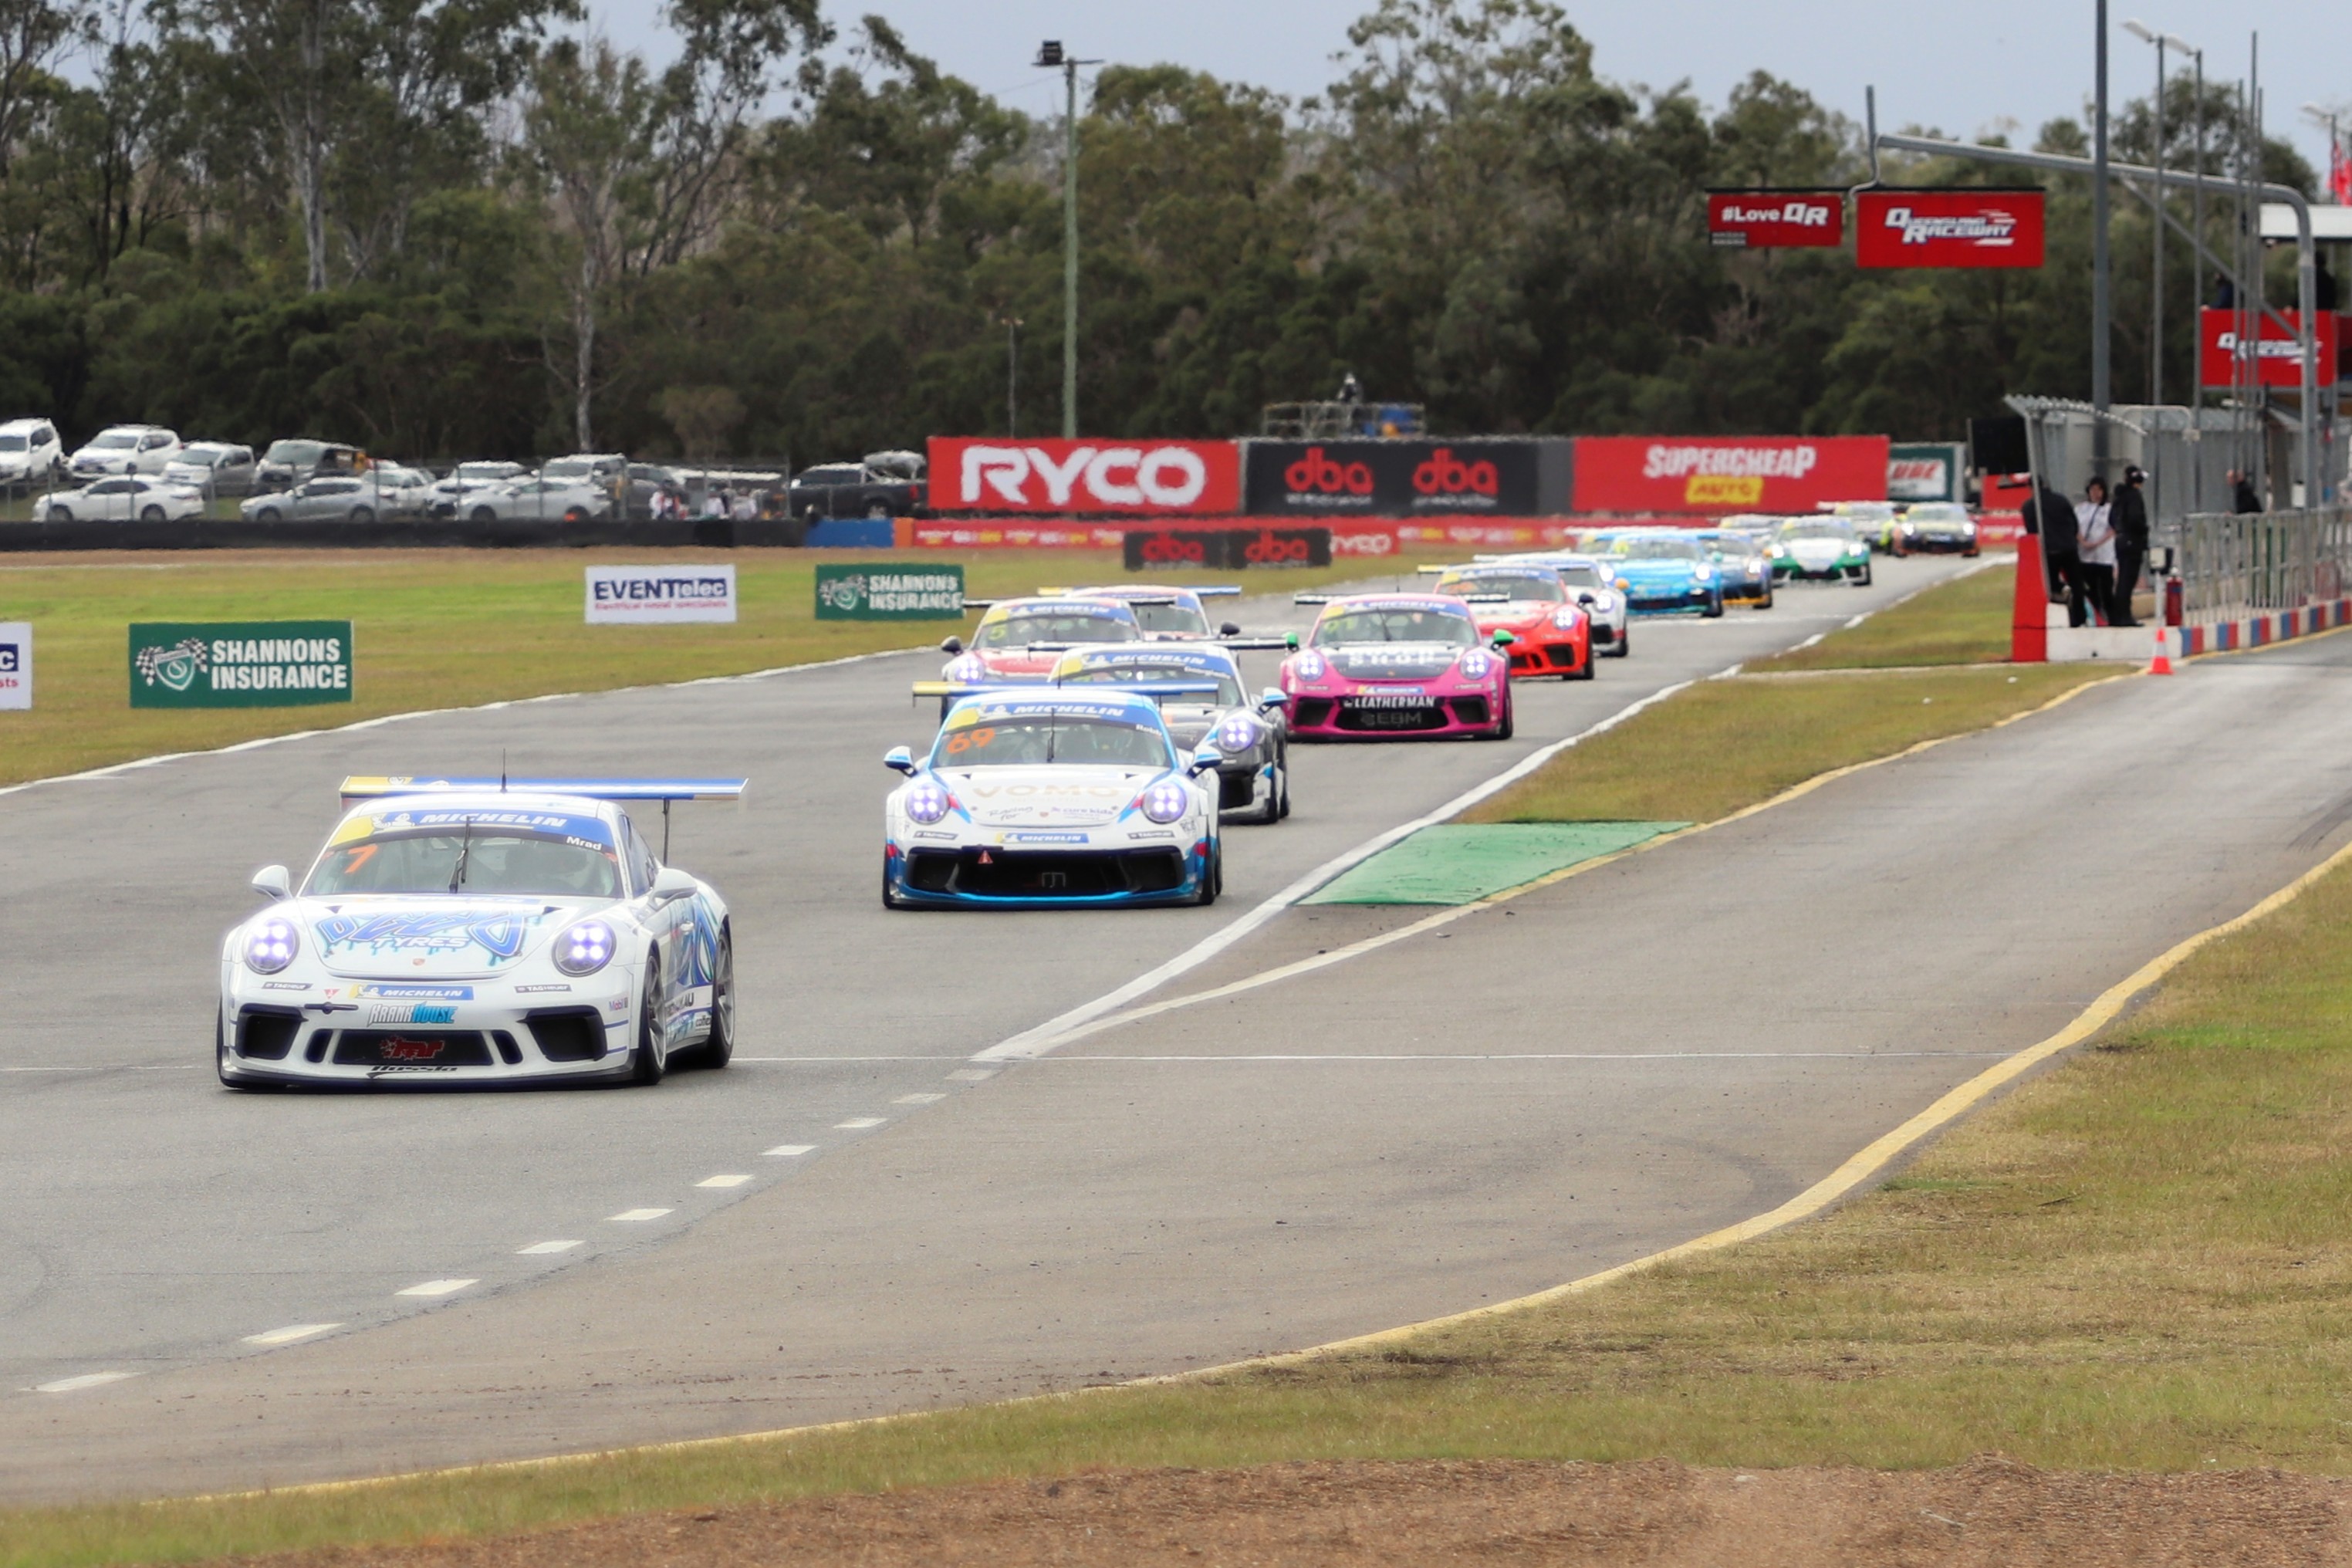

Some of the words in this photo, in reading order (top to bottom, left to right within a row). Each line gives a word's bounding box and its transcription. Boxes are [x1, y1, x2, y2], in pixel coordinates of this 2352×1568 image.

[1722, 206, 1780, 221] #Love
[1783, 202, 1828, 226] QR
[1902, 224, 2012, 244] RACEWAY
[1284, 446, 1374, 495] dba
[1412, 447, 1499, 495] dba
[1643, 444, 1816, 478] SUPERCHEAP
[961, 444, 1206, 506] RYCO
[869, 575, 957, 593] SHANNONS
[869, 593, 961, 611] INSURANCE
[211, 638, 340, 664] SHANNONS
[211, 664, 346, 689] INSURANCE
[1013, 705, 1124, 716] MICHELIN
[1355, 696, 1435, 708] LEATHERMAN
[947, 728, 995, 753] 69
[420, 813, 567, 827] MICHELIN
[566, 836, 602, 850] Mrad
[344, 844, 378, 874] 7
[373, 936, 469, 948] TYRES
